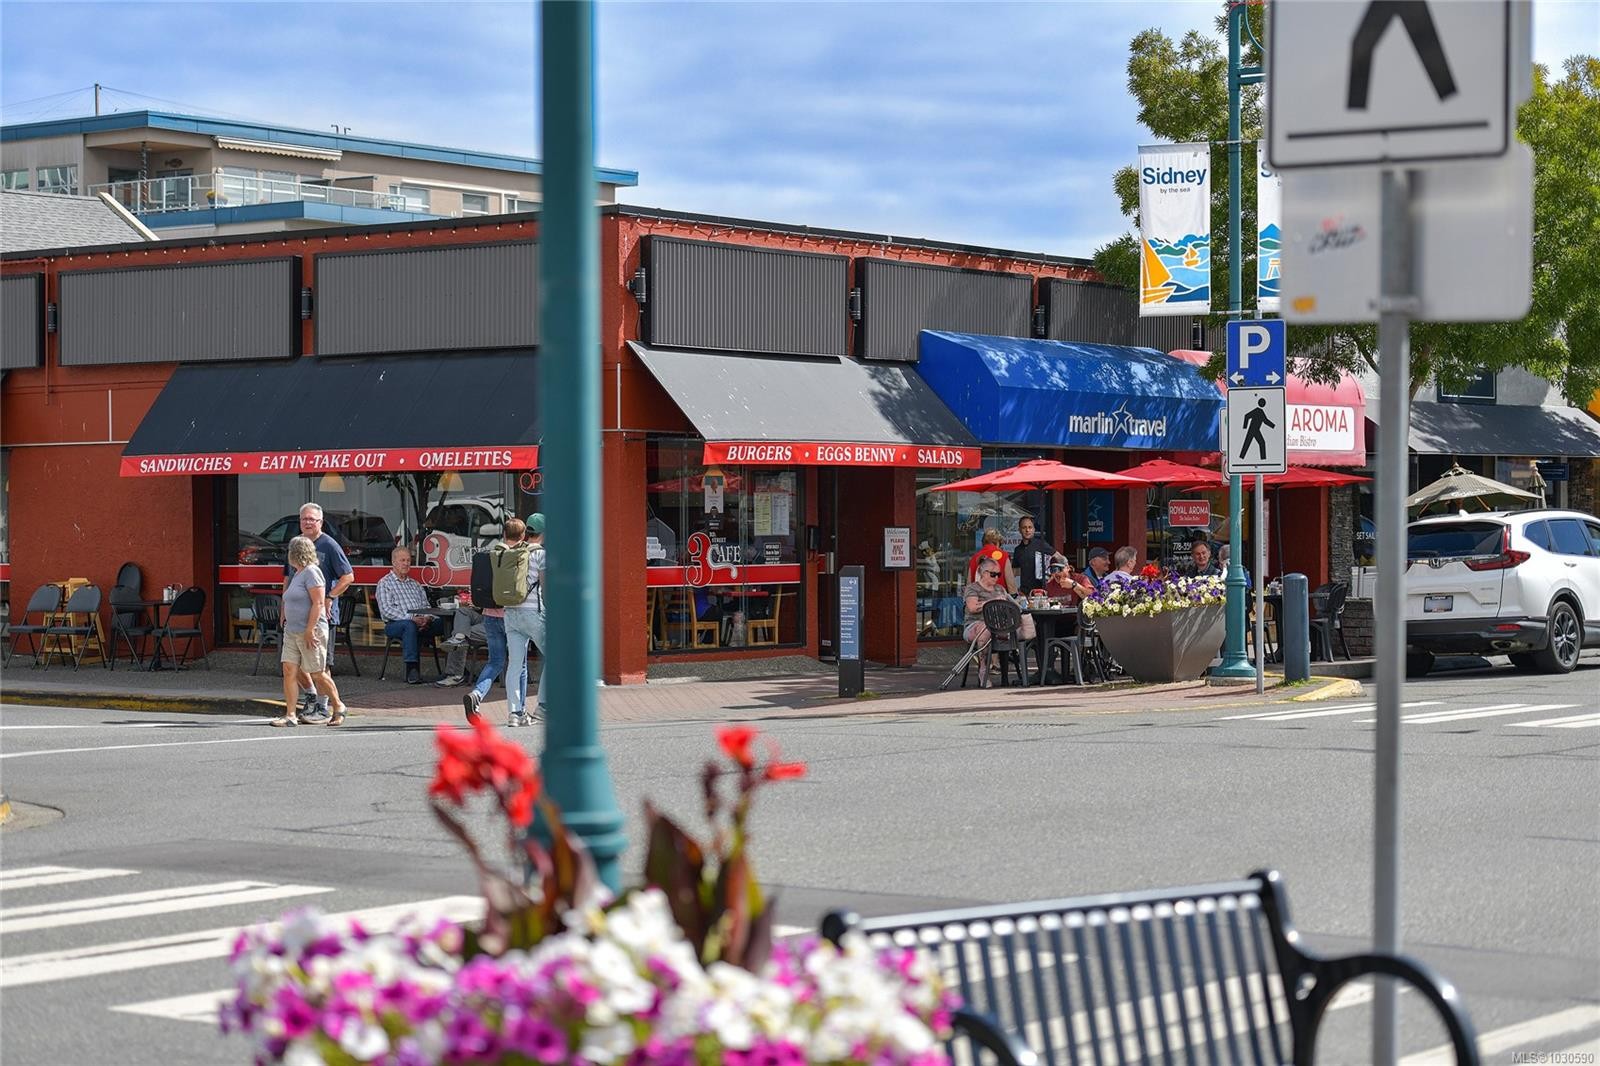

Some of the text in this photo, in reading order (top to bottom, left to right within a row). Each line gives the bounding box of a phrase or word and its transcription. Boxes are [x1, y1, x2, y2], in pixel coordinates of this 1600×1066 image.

[1142, 166, 1207, 185] Sidney
[1239, 325, 1271, 369] P
[1069, 412, 1167, 437] marlin travel
[1291, 408, 1348, 432] AROMA
[1300, 434, 1317, 447] Bistro
[140, 457, 232, 473] SANDWICHES
[260, 455, 288, 470] EAT
[290, 455, 307, 469] IN
[354, 452, 386, 468] OUT
[419, 450, 513, 468] OMELETTES
[727, 445, 963, 465] BURGERS EGGS BENNY SALADS
[520, 472, 544, 490] OP
[1170, 505, 1209, 515] ROYAL AROMA
[1356, 531, 1365, 540] SET
[421, 533, 453, 587] 3
[686, 532, 713, 588] 3
